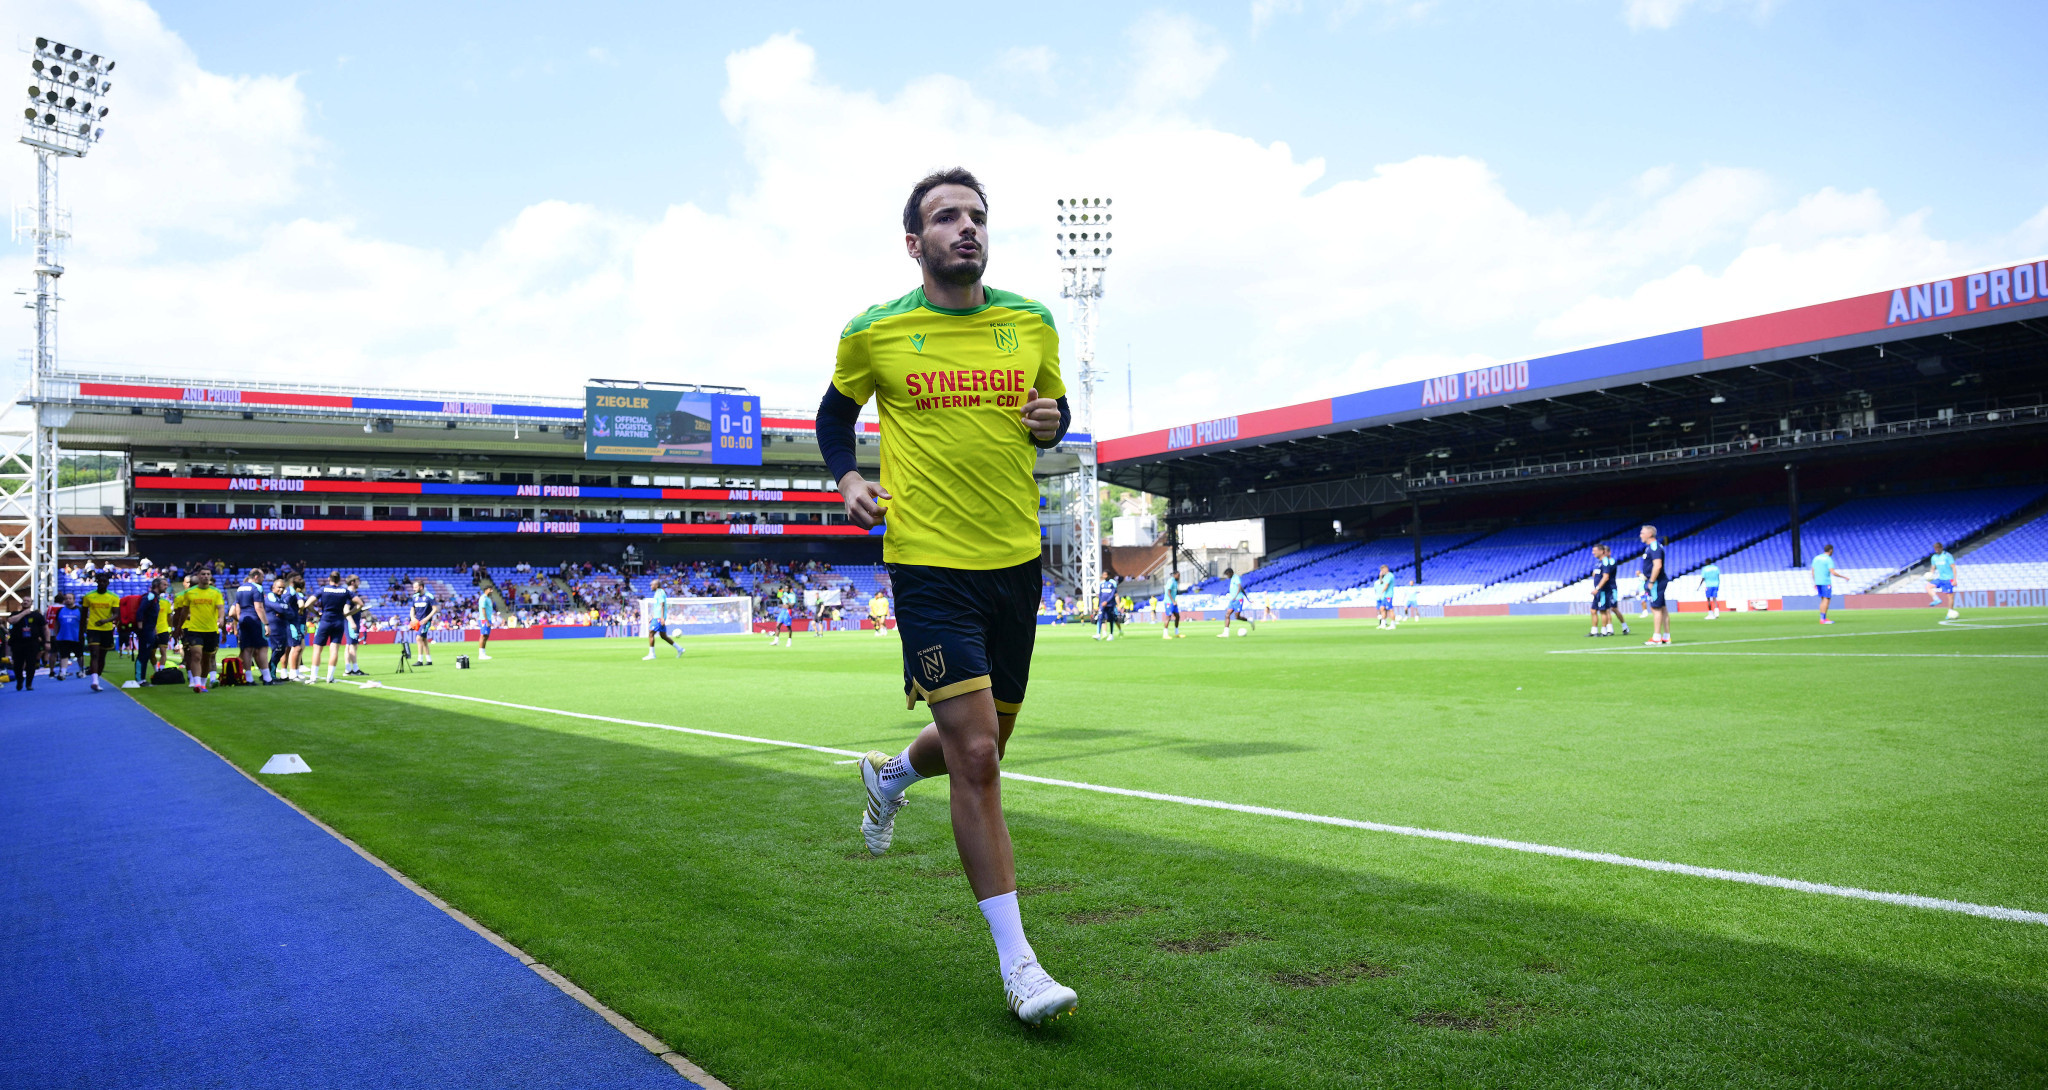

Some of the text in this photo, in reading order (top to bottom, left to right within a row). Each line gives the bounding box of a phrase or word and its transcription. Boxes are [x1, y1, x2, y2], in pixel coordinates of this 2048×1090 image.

[1887, 279, 1954, 325] AND
[906, 370, 1025, 396] SYNERGIE
[1422, 361, 1529, 406] AND PROUD
[182, 388, 241, 402] AND PROUD
[442, 402, 492, 415] AND PROUD
[596, 395, 649, 409] ZIEGLER
[916, 395, 980, 410] INTERIM
[997, 395, 1019, 407] CDI
[615, 415, 649, 424] OFFICIAL
[615, 423, 652, 431] LOGISTICS
[1168, 416, 1239, 449] AND PROUD
[615, 430, 649, 438] PARTNER
[720, 436, 753, 449] 00:00
[229, 478, 304, 491] AND PROUD
[517, 485, 580, 497] AND PROUD
[729, 490, 783, 501] AND PROUD
[229, 518, 304, 531] AND PROUD
[517, 521, 580, 533] AND PROUD
[729, 524, 783, 534] AND PROUD
[1953, 590, 1988, 608] AND
[606, 625, 627, 637] AND
